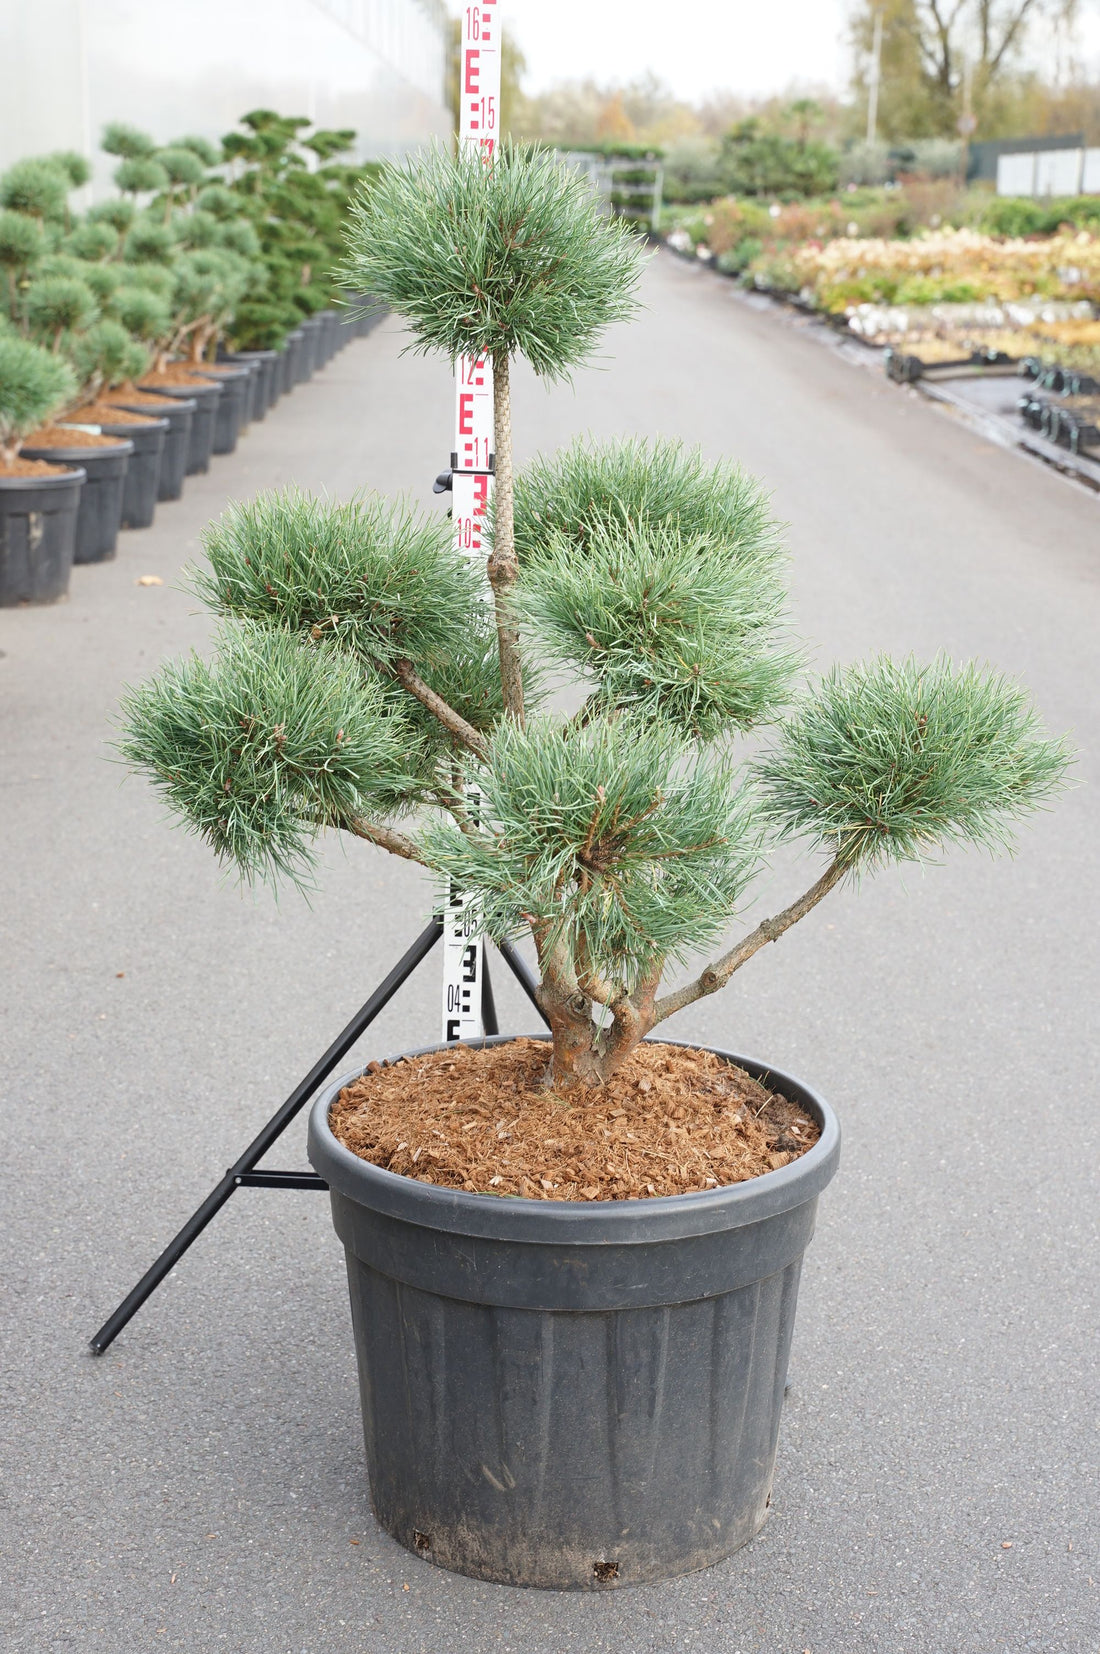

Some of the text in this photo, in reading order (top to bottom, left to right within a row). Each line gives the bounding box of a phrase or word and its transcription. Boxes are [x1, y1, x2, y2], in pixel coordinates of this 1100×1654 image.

[466, 6, 480, 41] 16
[481, 96, 495, 130] 15
[460, 352, 475, 385] 12
[474, 437, 489, 467] 11
[457, 517, 472, 549] 10
[447, 984, 461, 1013] 04
